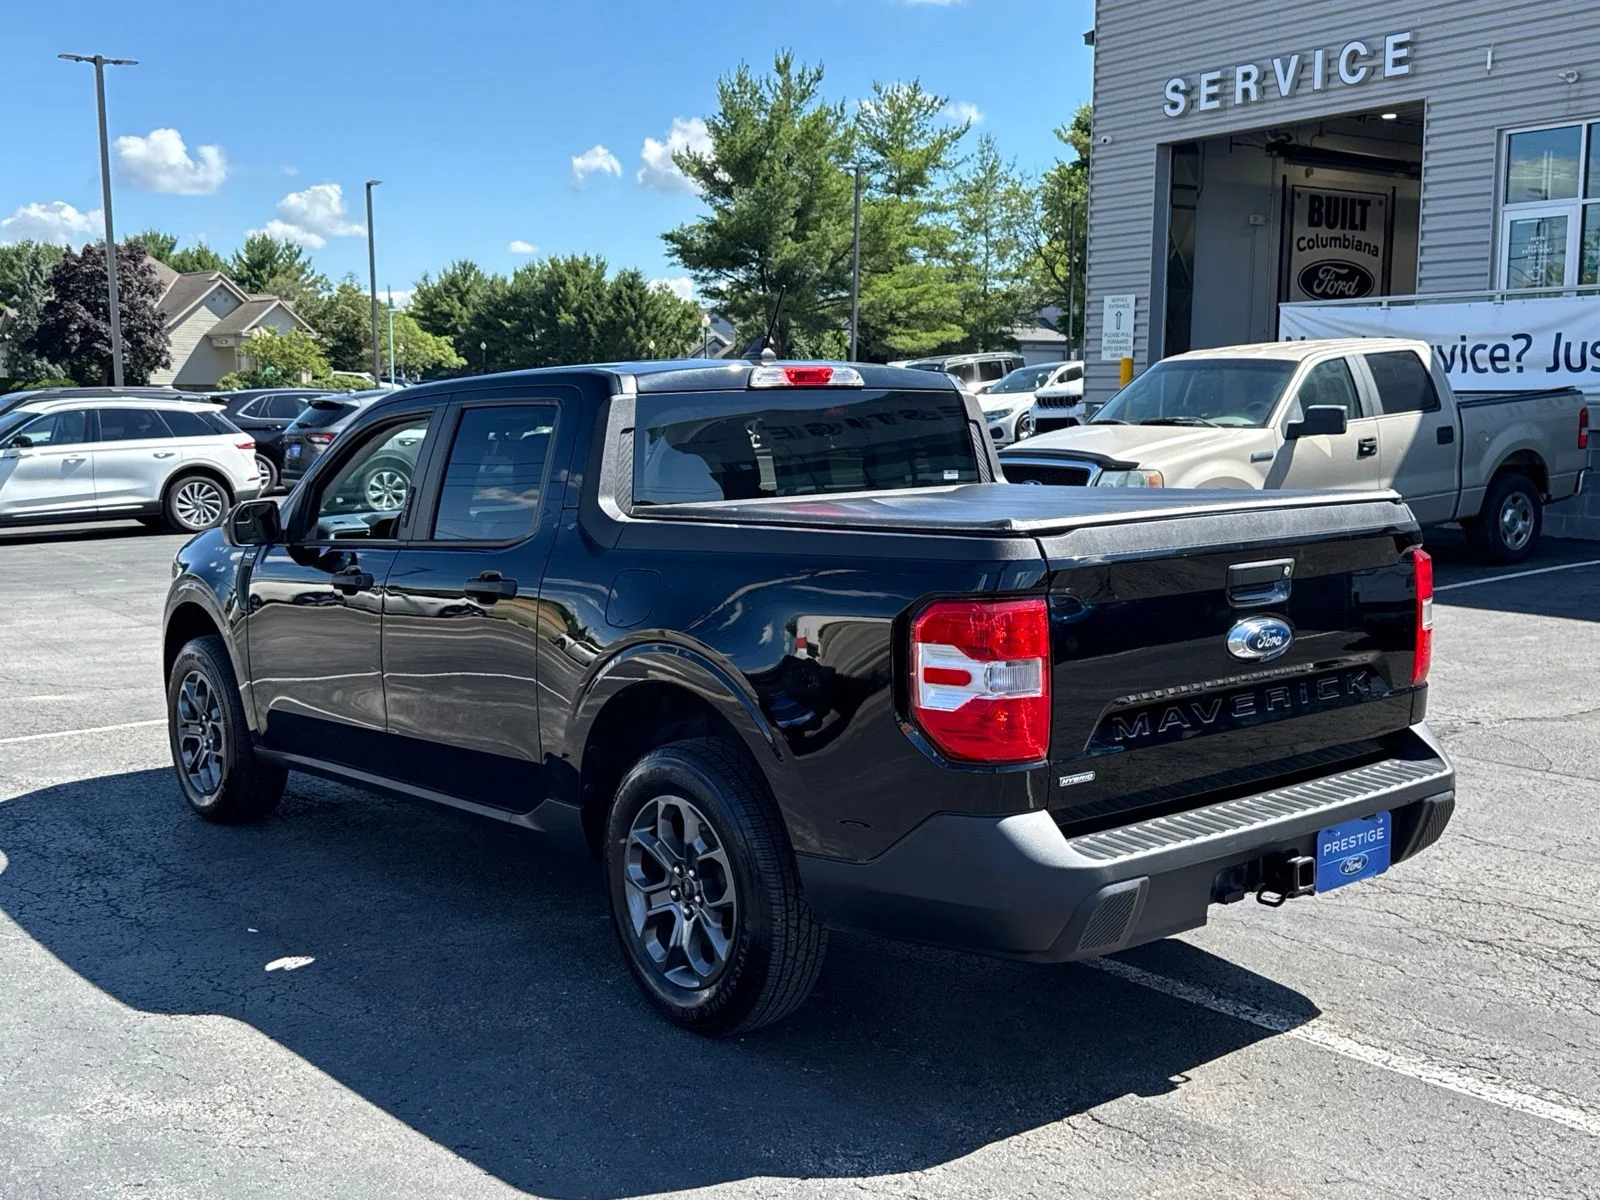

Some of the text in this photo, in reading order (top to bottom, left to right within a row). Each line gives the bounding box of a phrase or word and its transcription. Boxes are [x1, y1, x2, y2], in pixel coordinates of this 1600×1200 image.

[1162, 30, 1413, 119] SERVICE
[1307, 194, 1371, 231] BUILT
[1296, 233, 1379, 257] Columbiana
[1313, 265, 1360, 296] Ford
[1430, 332, 1533, 374] vice?
[1112, 670, 1370, 741] MAVERICK
[1061, 772, 1094, 785] HYBRID
[1323, 827, 1384, 856] PRESTIGE
[1344, 856, 1364, 873] Ford
